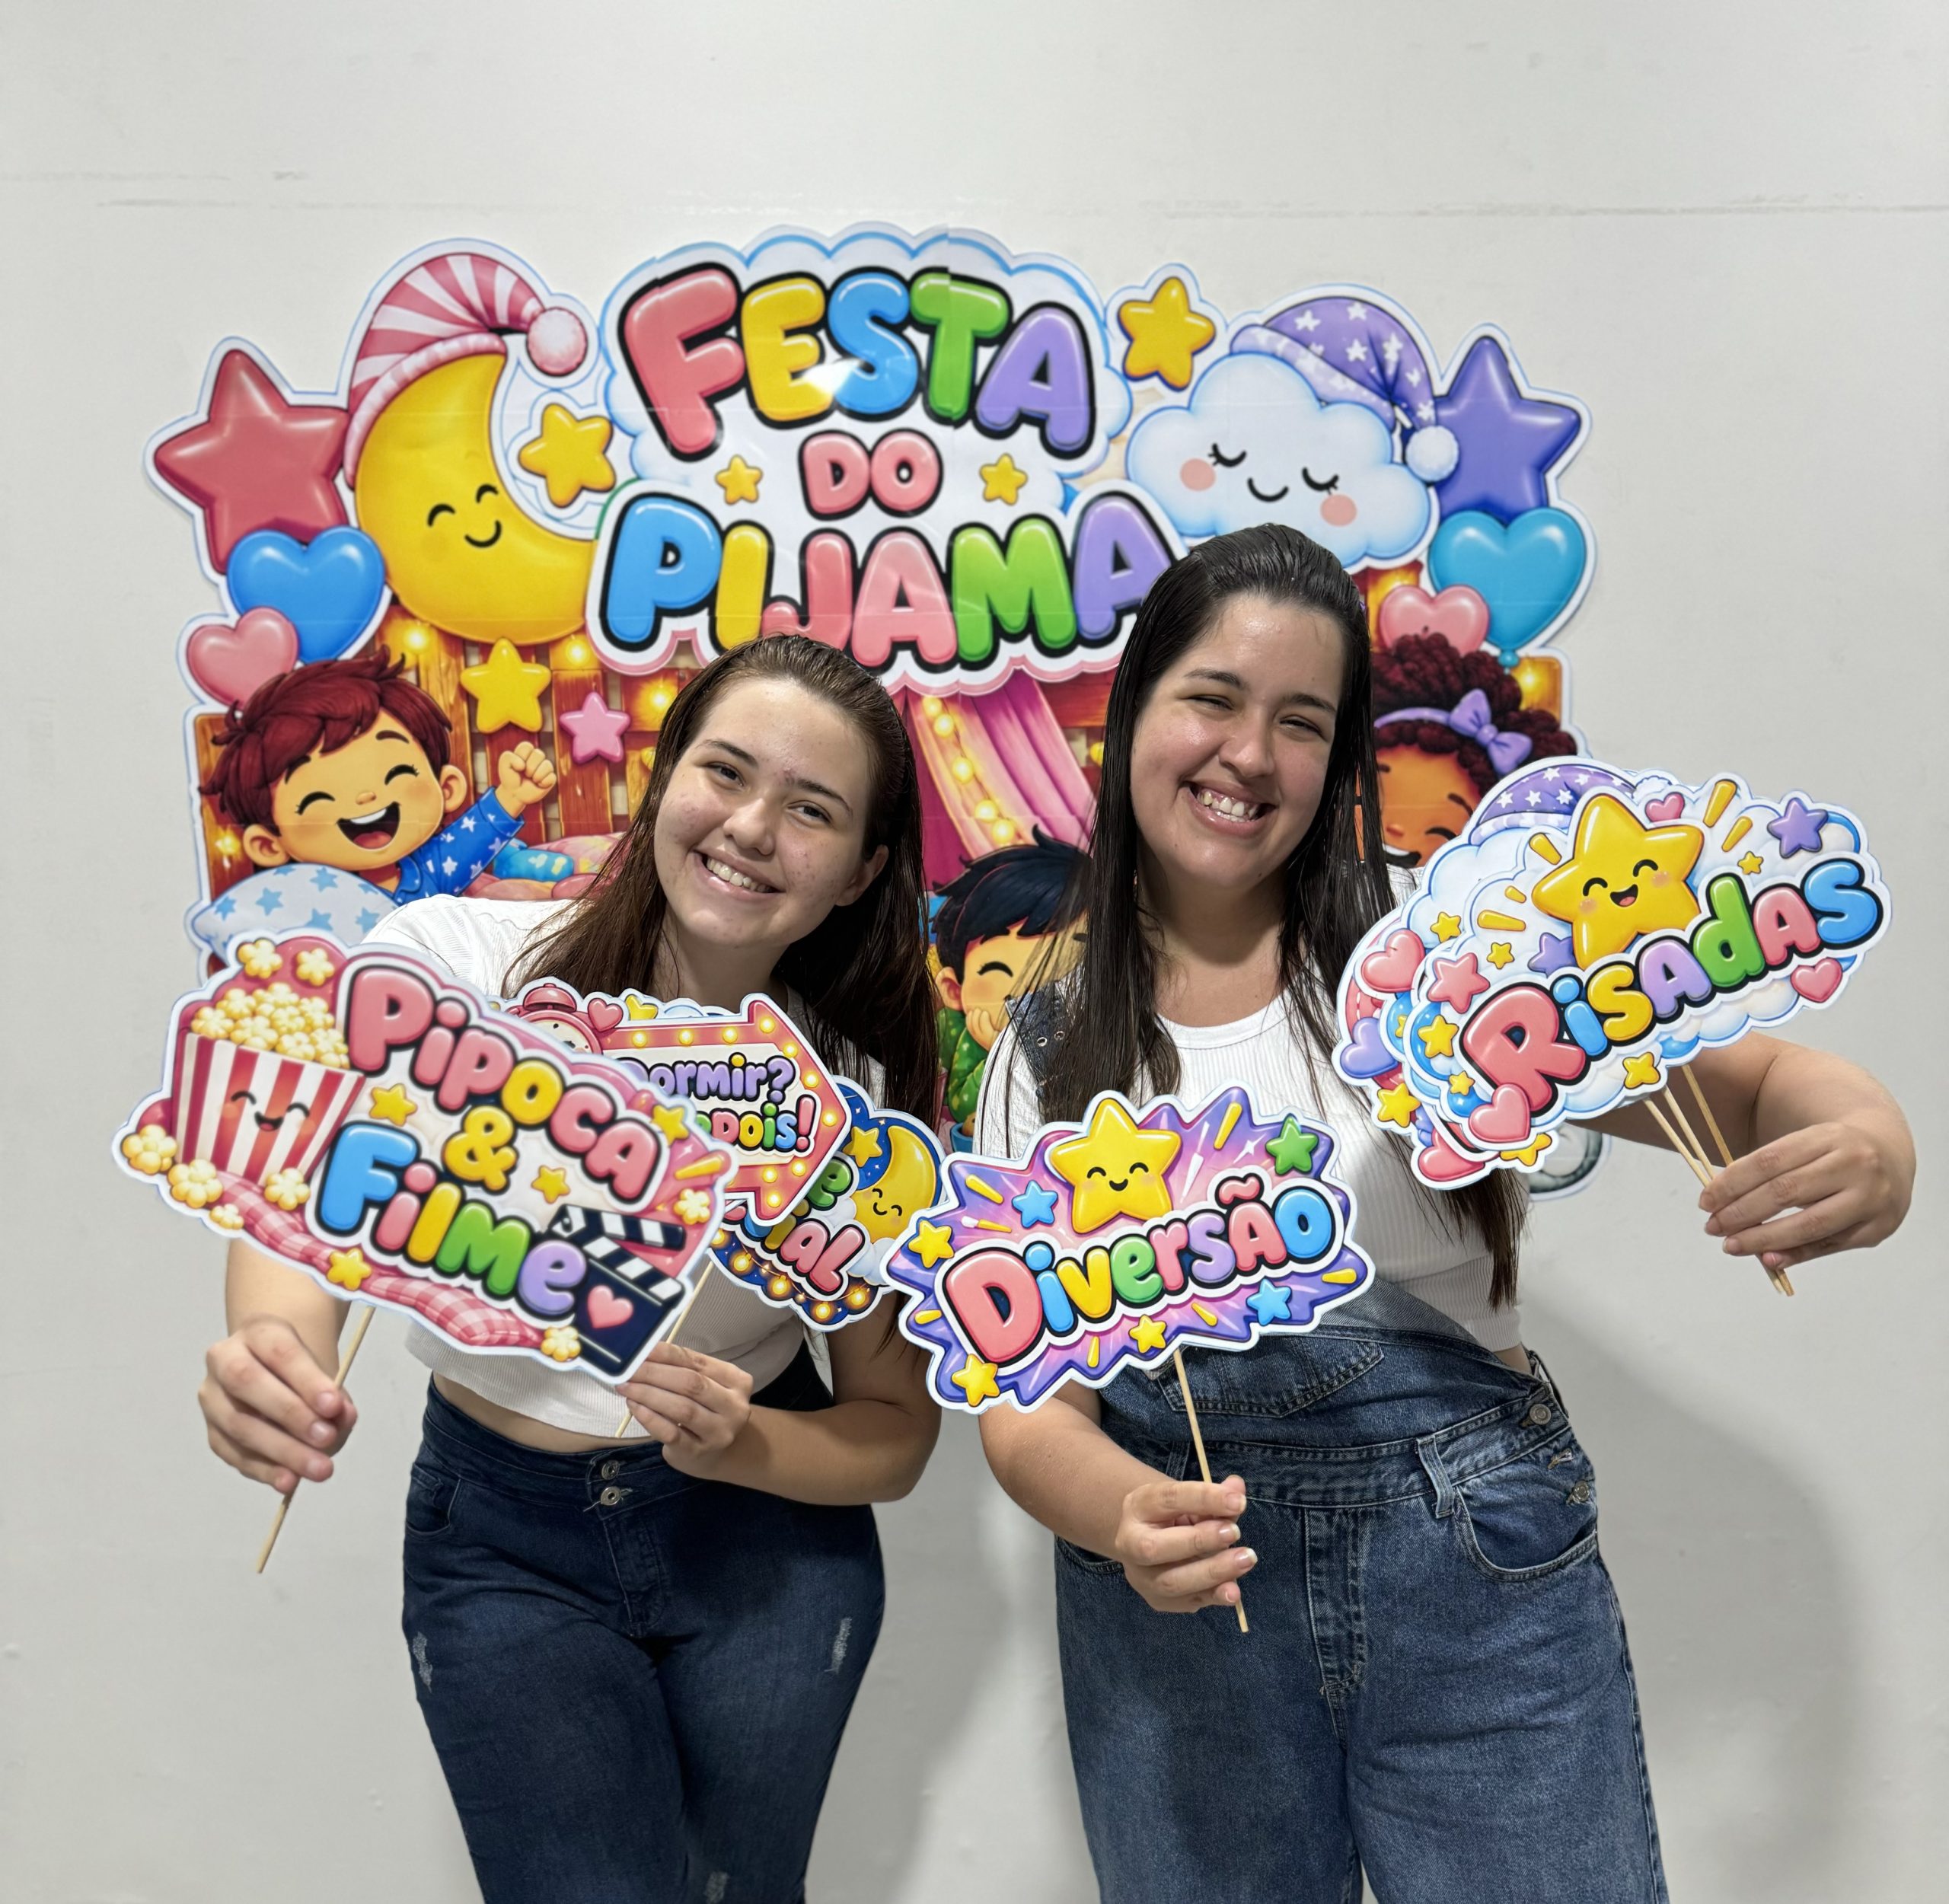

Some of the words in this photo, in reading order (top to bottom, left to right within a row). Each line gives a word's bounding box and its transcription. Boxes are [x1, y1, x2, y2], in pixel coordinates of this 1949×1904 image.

[617, 263, 1096, 461] FESTA
[799, 429, 943, 521] DO
[601, 490, 1172, 675] PIJAMA
[442, 1103, 518, 1195] &
